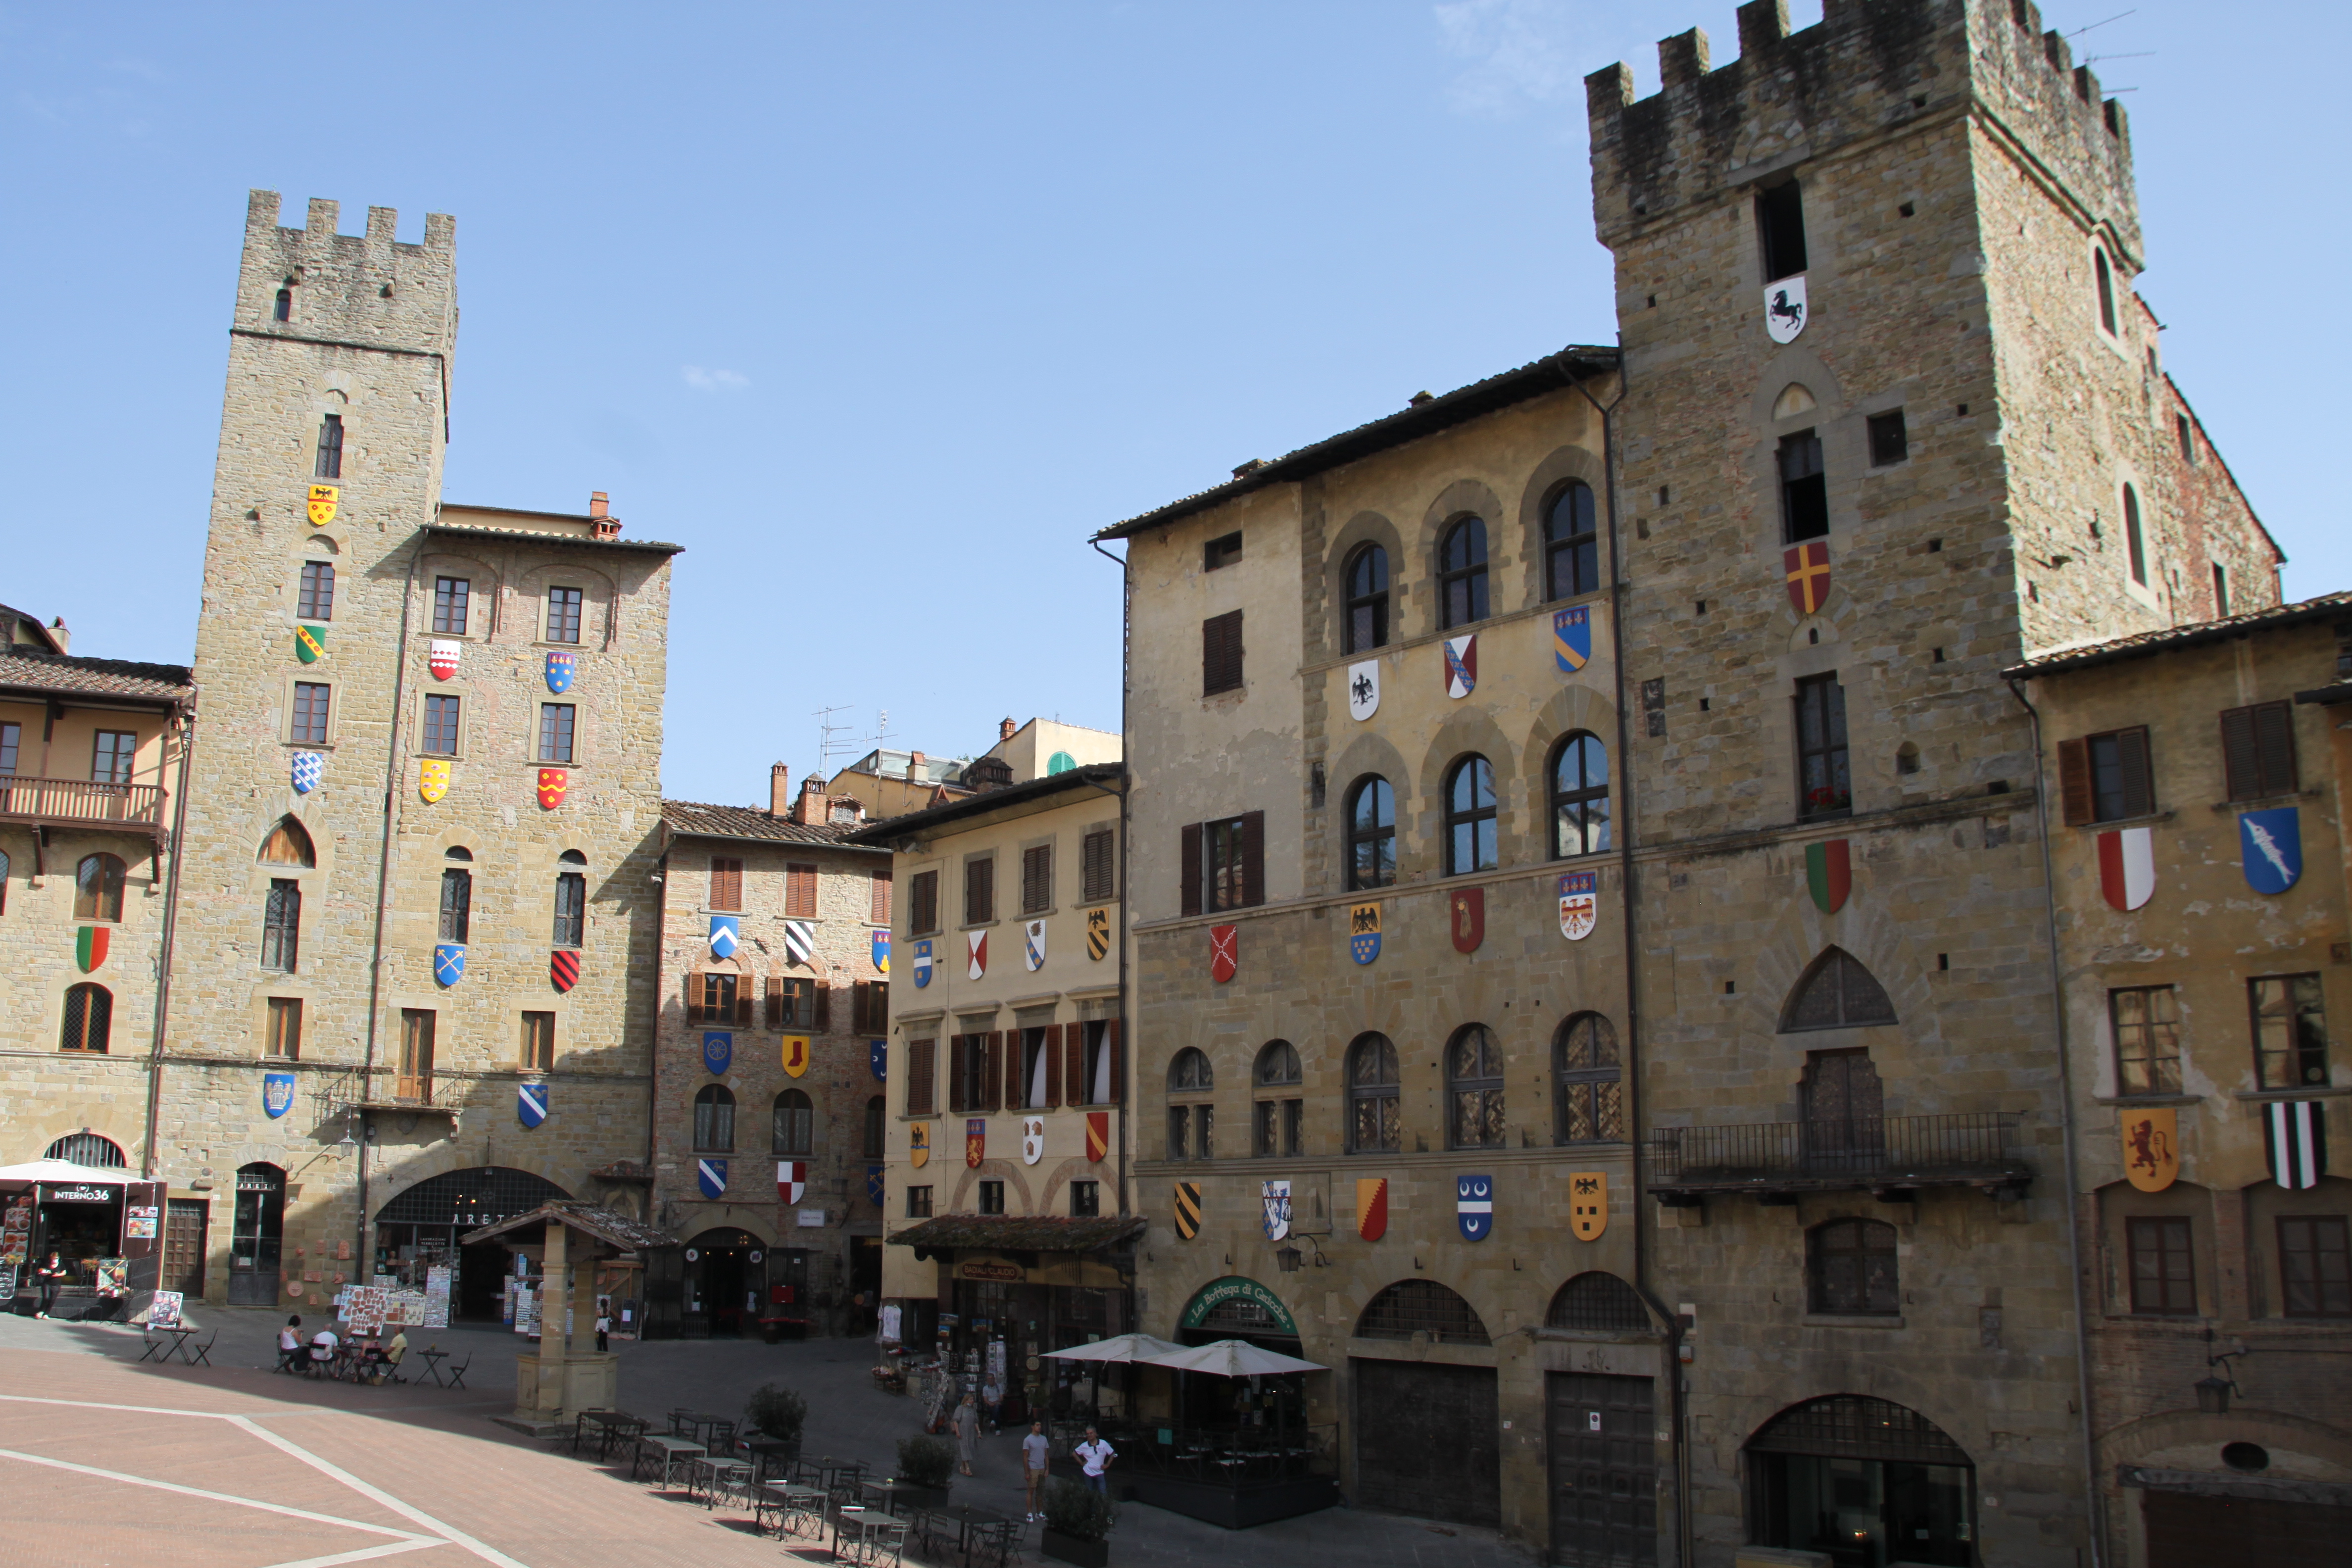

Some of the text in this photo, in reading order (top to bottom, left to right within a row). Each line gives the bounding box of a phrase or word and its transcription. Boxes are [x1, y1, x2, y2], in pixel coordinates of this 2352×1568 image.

[964, 1266, 1015, 1276] BADIALI CLAUDIO
[1191, 1283, 1287, 1323] La Bottega di Gnicche
